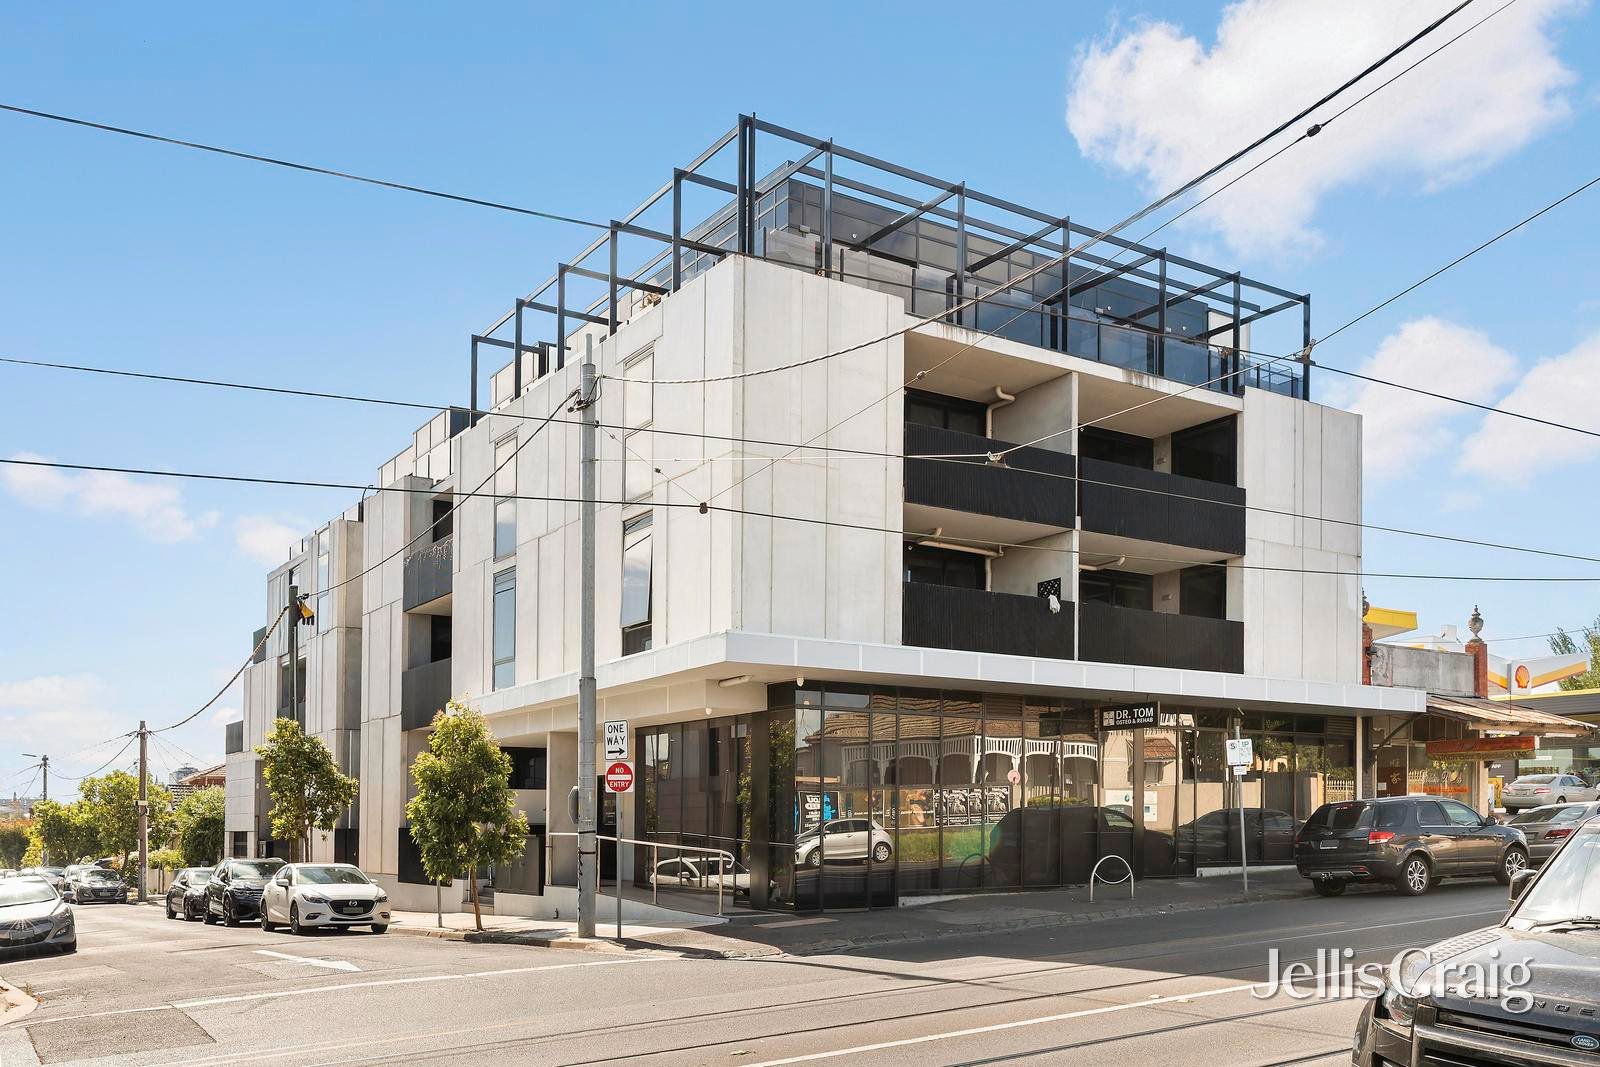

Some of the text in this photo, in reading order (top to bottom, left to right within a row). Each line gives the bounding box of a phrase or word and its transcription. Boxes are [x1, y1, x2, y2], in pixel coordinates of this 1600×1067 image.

[1115, 707, 1154, 720] DR. TOM
[1136, 716, 1154, 724] REHAB
[608, 724, 624, 733] ONE
[607, 736, 625, 745] WAY
